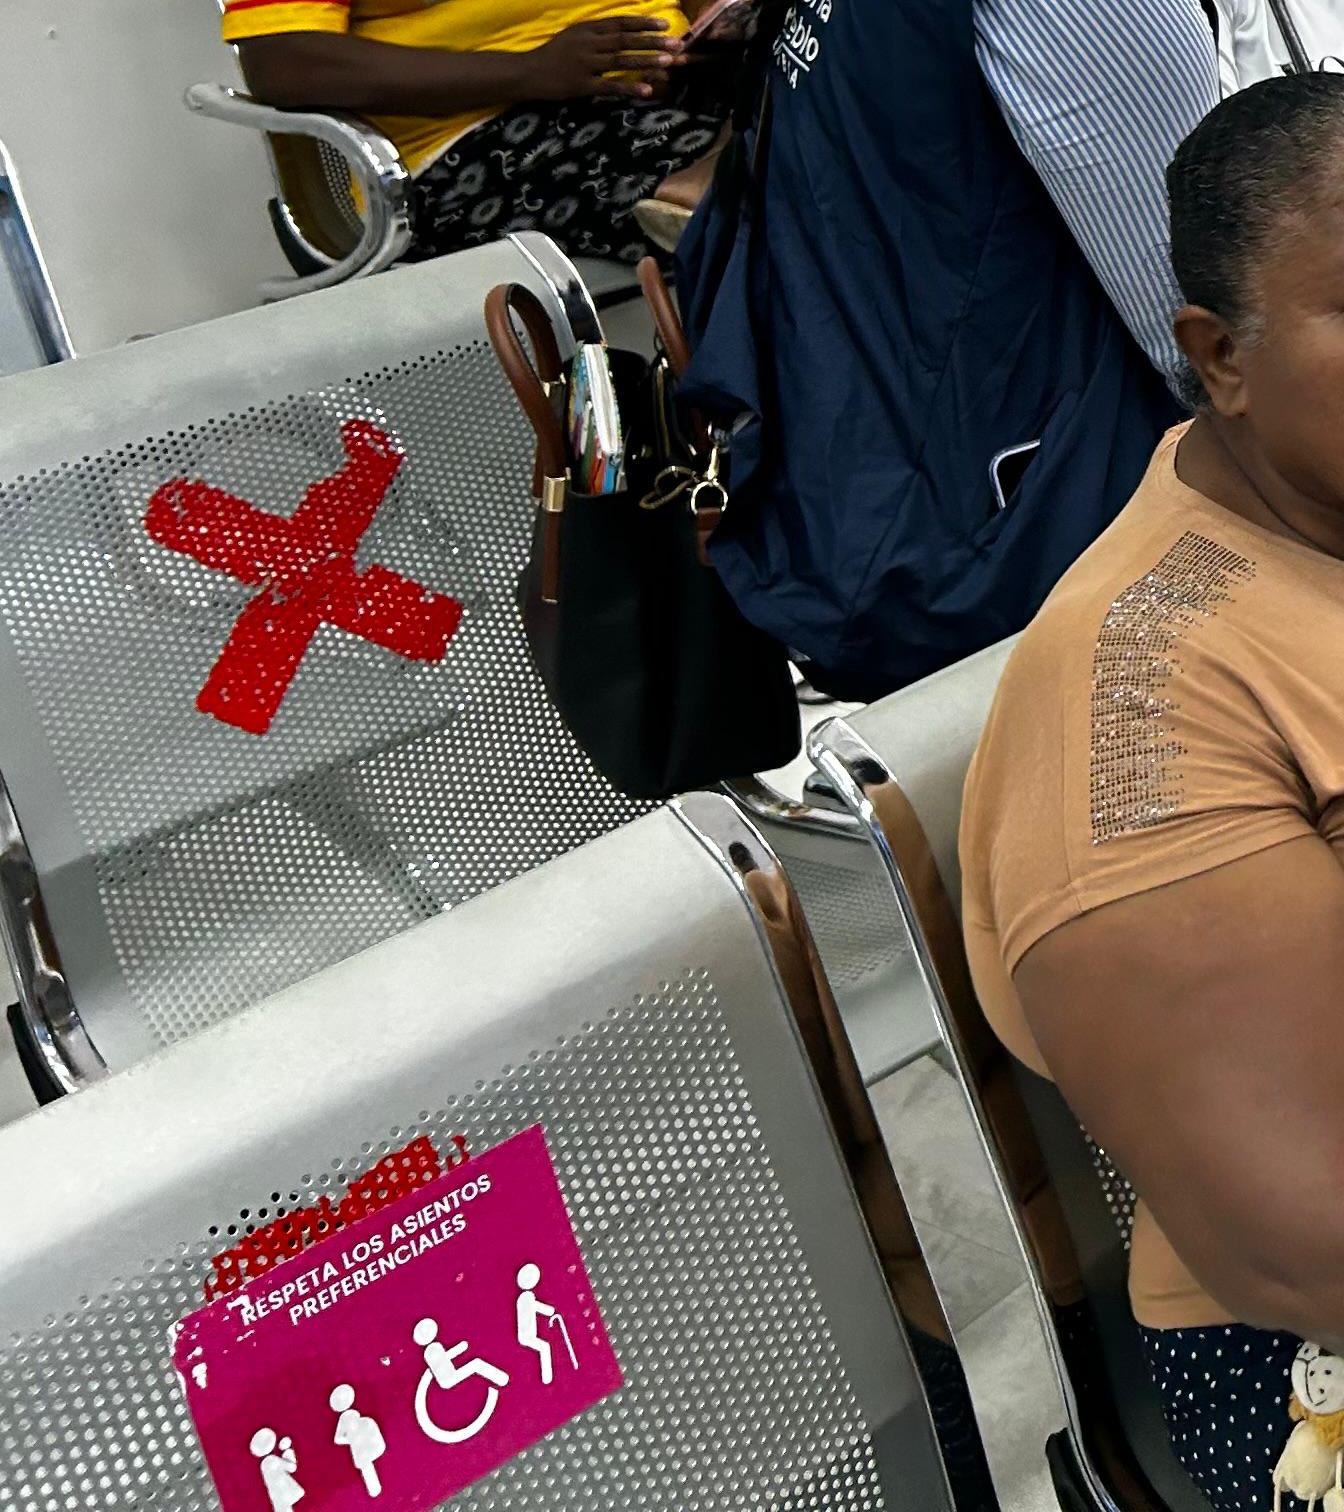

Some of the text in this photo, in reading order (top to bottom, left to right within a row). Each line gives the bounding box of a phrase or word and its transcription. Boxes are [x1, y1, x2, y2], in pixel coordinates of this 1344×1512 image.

[240, 1173, 493, 1326] RESPETA LOS ASIENTOS
[288, 1212, 468, 1327] PREFERENCIALES
